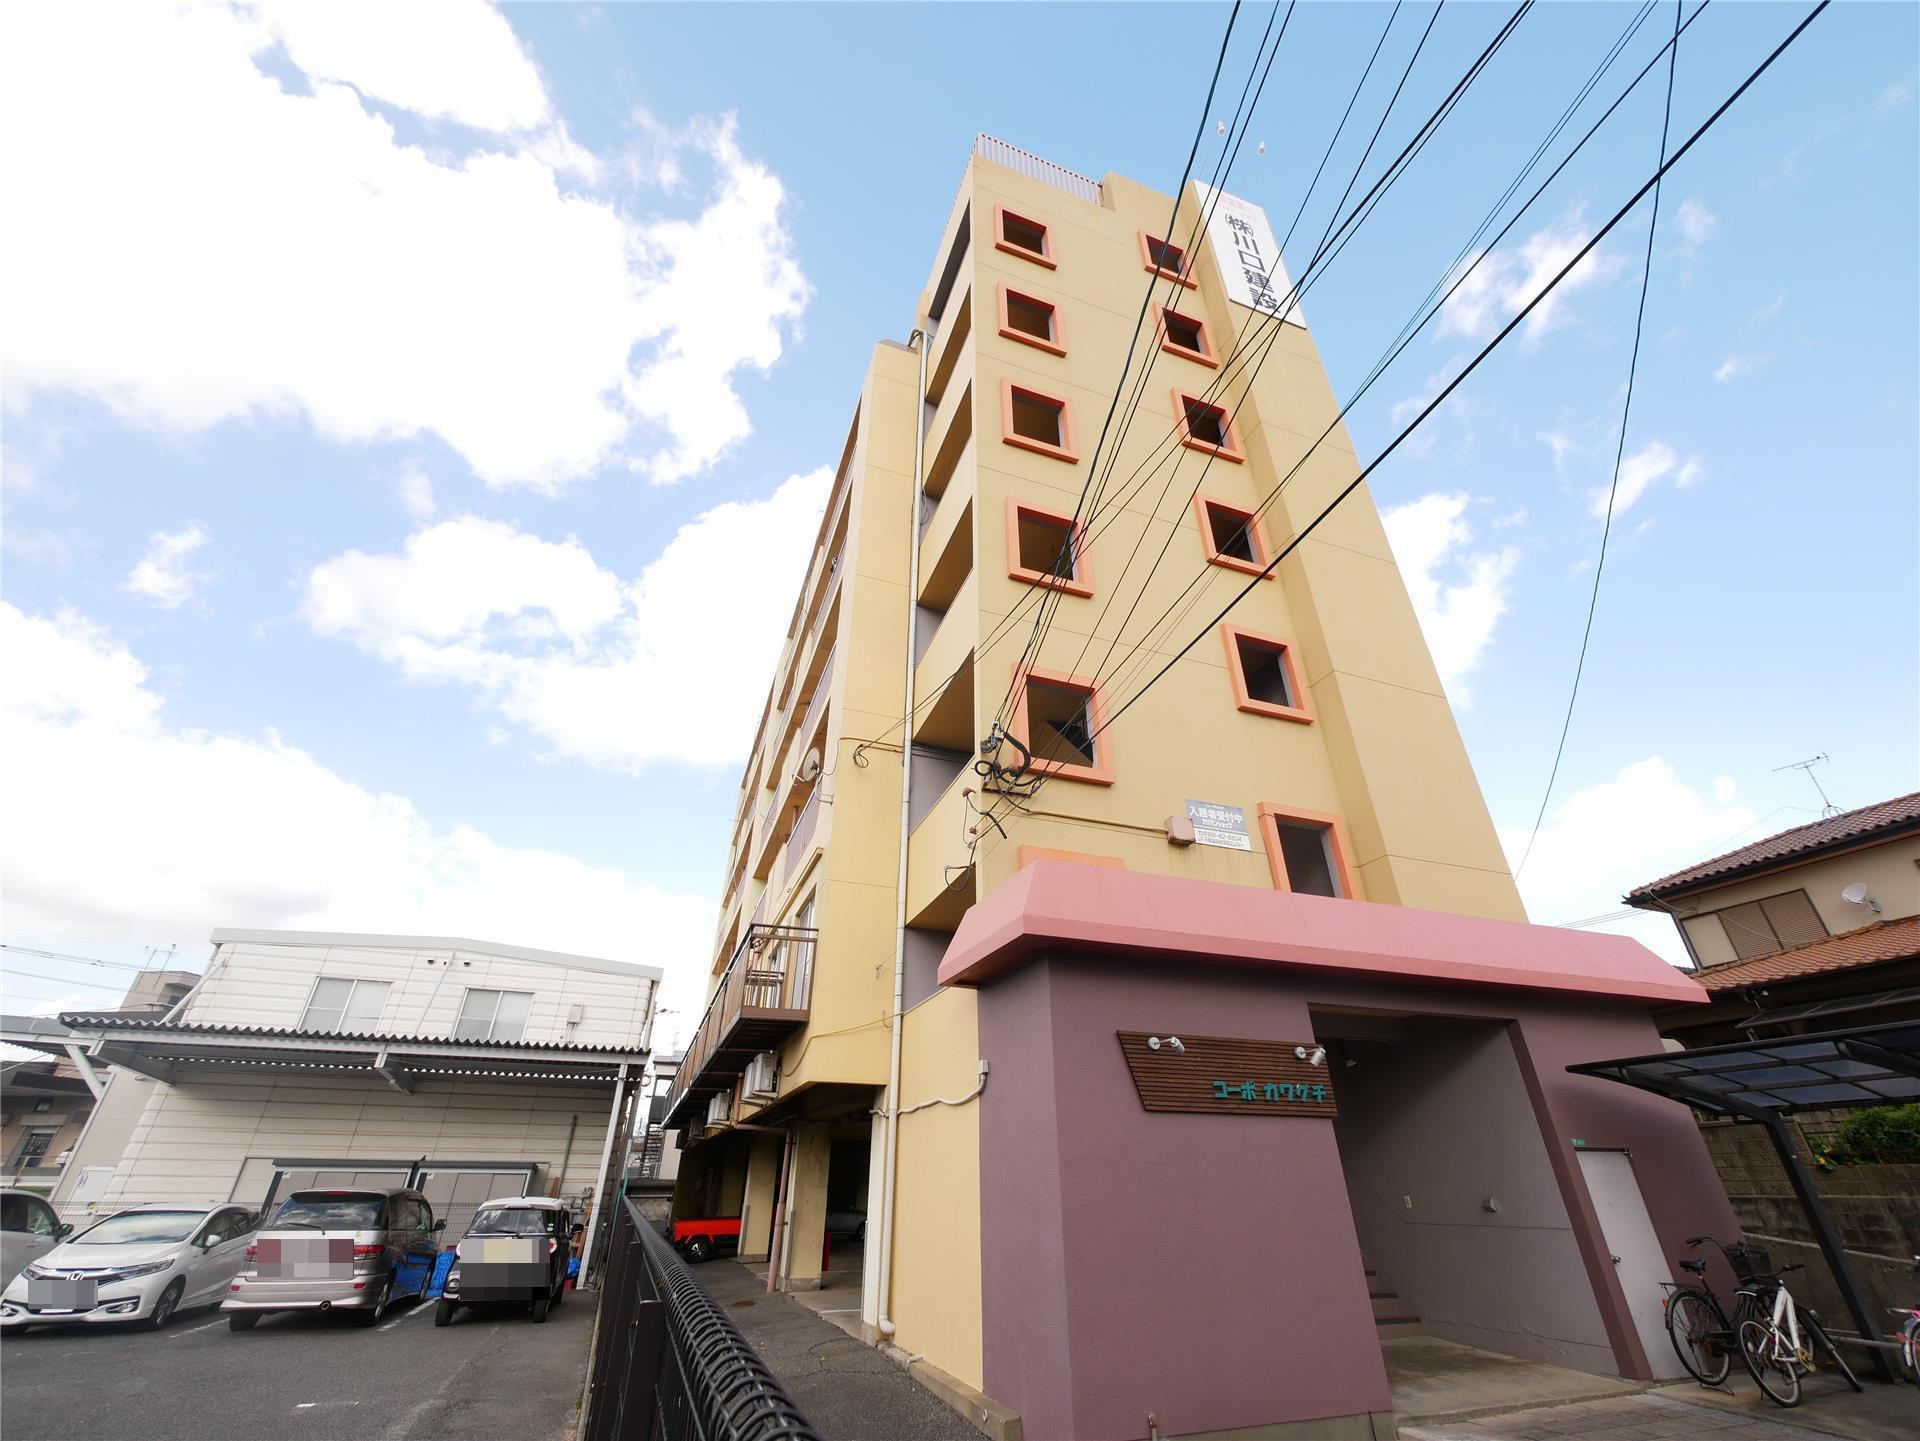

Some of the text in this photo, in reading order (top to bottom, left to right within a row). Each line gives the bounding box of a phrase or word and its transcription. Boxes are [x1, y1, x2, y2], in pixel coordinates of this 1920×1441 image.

[1189, 806, 1243, 824] 入居者受付中
[1213, 1081, 1257, 1100] コーポ
